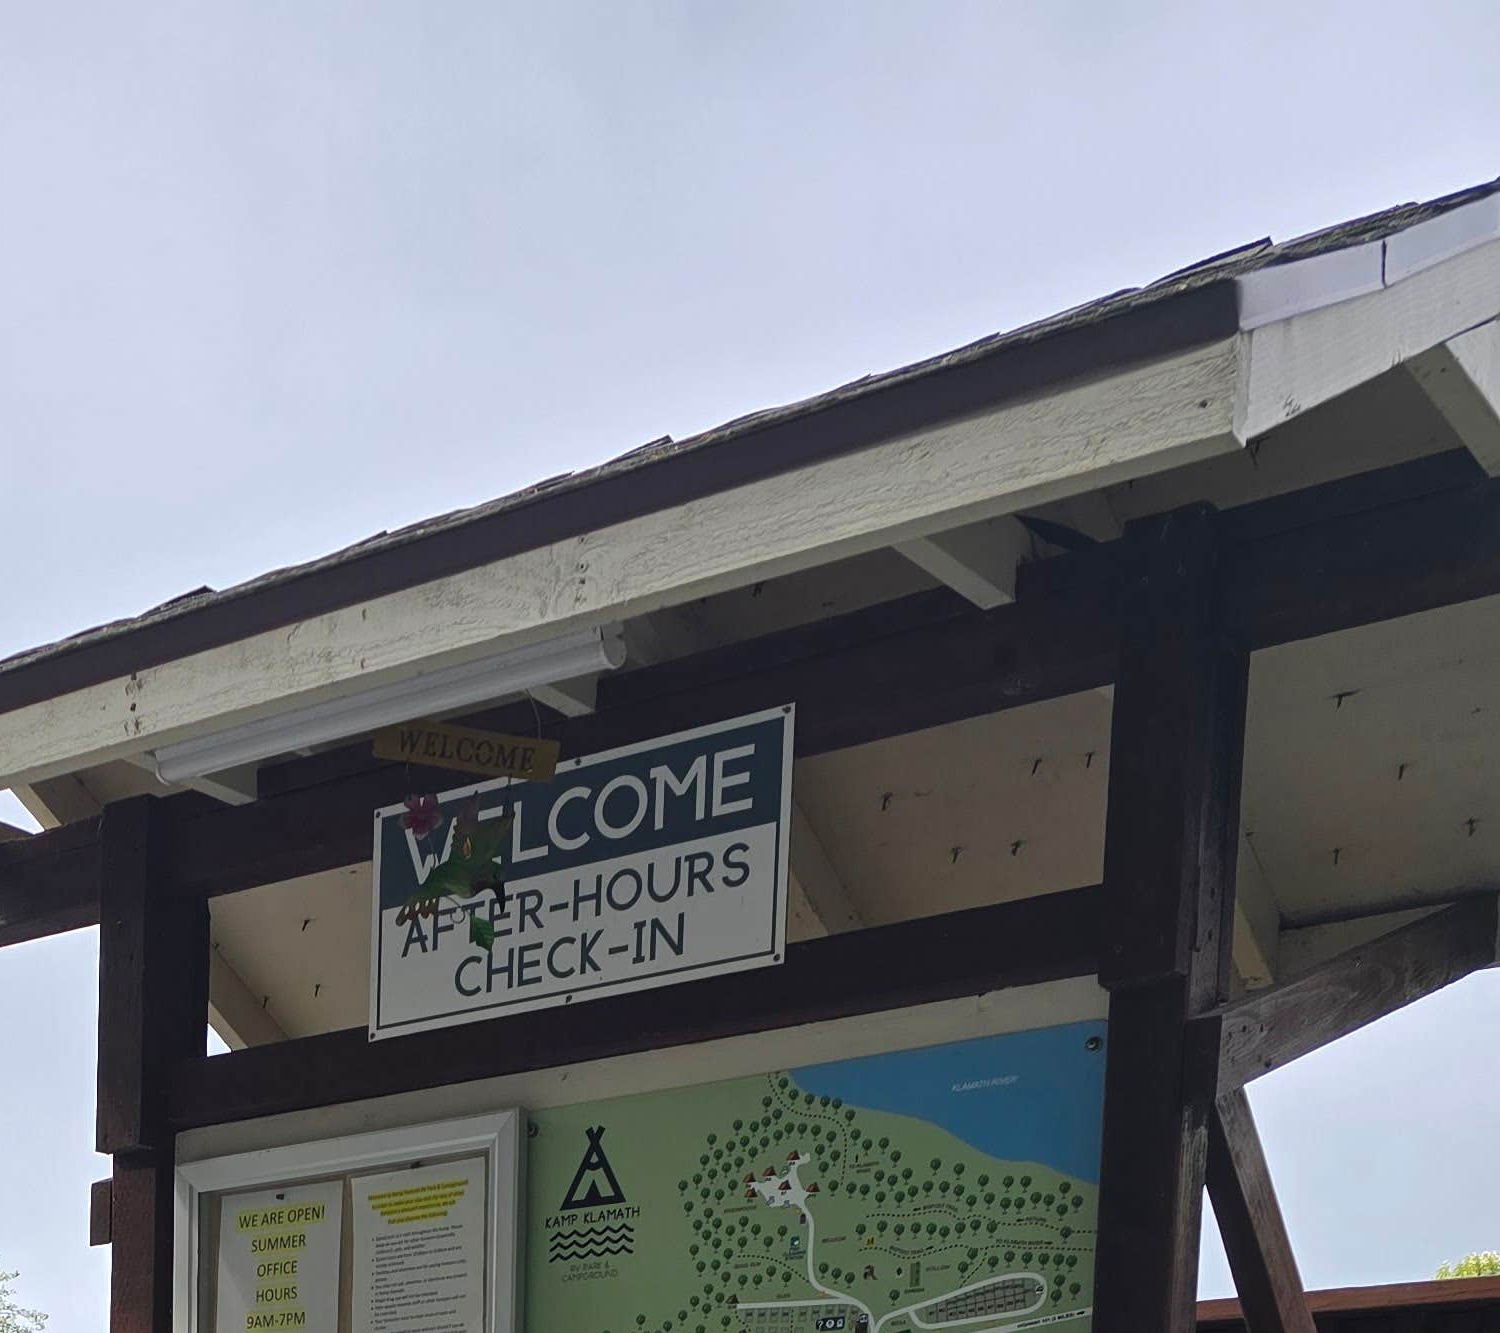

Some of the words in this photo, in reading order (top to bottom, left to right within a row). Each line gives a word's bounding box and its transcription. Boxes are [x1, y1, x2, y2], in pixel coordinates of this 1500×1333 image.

[400, 730, 536, 773] WELCOME
[401, 842, 750, 957] AFTER-HOURS
[454, 912, 685, 997] CHECK-IN
[239, 1214, 258, 1228] WE
[260, 1211, 284, 1226] ARE
[287, 1205, 325, 1223] OPEN!
[545, 1215, 578, 1229] KAMP
[584, 1206, 641, 1224] KLAMATH
[252, 1234, 306, 1252] SUMMER
[257, 1261, 298, 1277] OFFICE
[562, 1269, 618, 1282] CAMPGROUND
[256, 1287, 297, 1303] HOURS
[246, 1311, 306, 1329] 9AM-7PM
